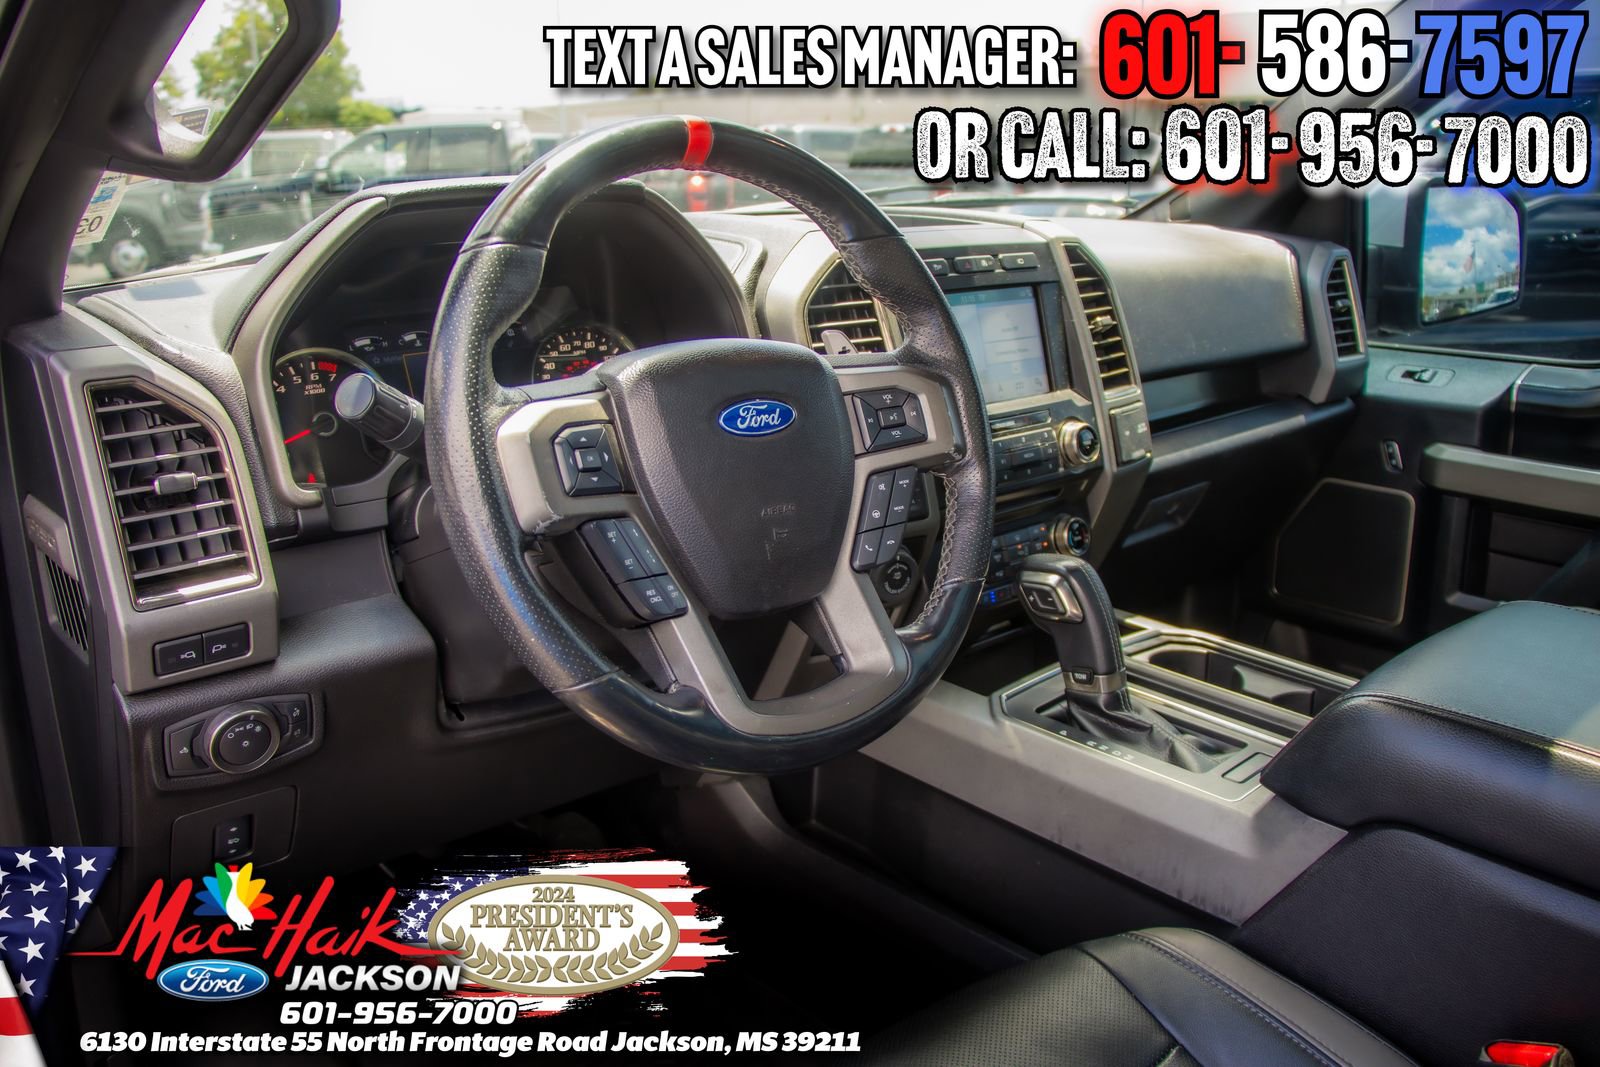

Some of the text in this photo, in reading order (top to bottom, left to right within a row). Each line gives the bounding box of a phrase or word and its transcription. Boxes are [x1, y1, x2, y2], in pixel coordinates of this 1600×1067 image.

[276, 372, 337, 394] 4 5 6 7
[737, 404, 782, 430] Ford
[607, 531, 617, 539] SET
[624, 558, 634, 566] SET
